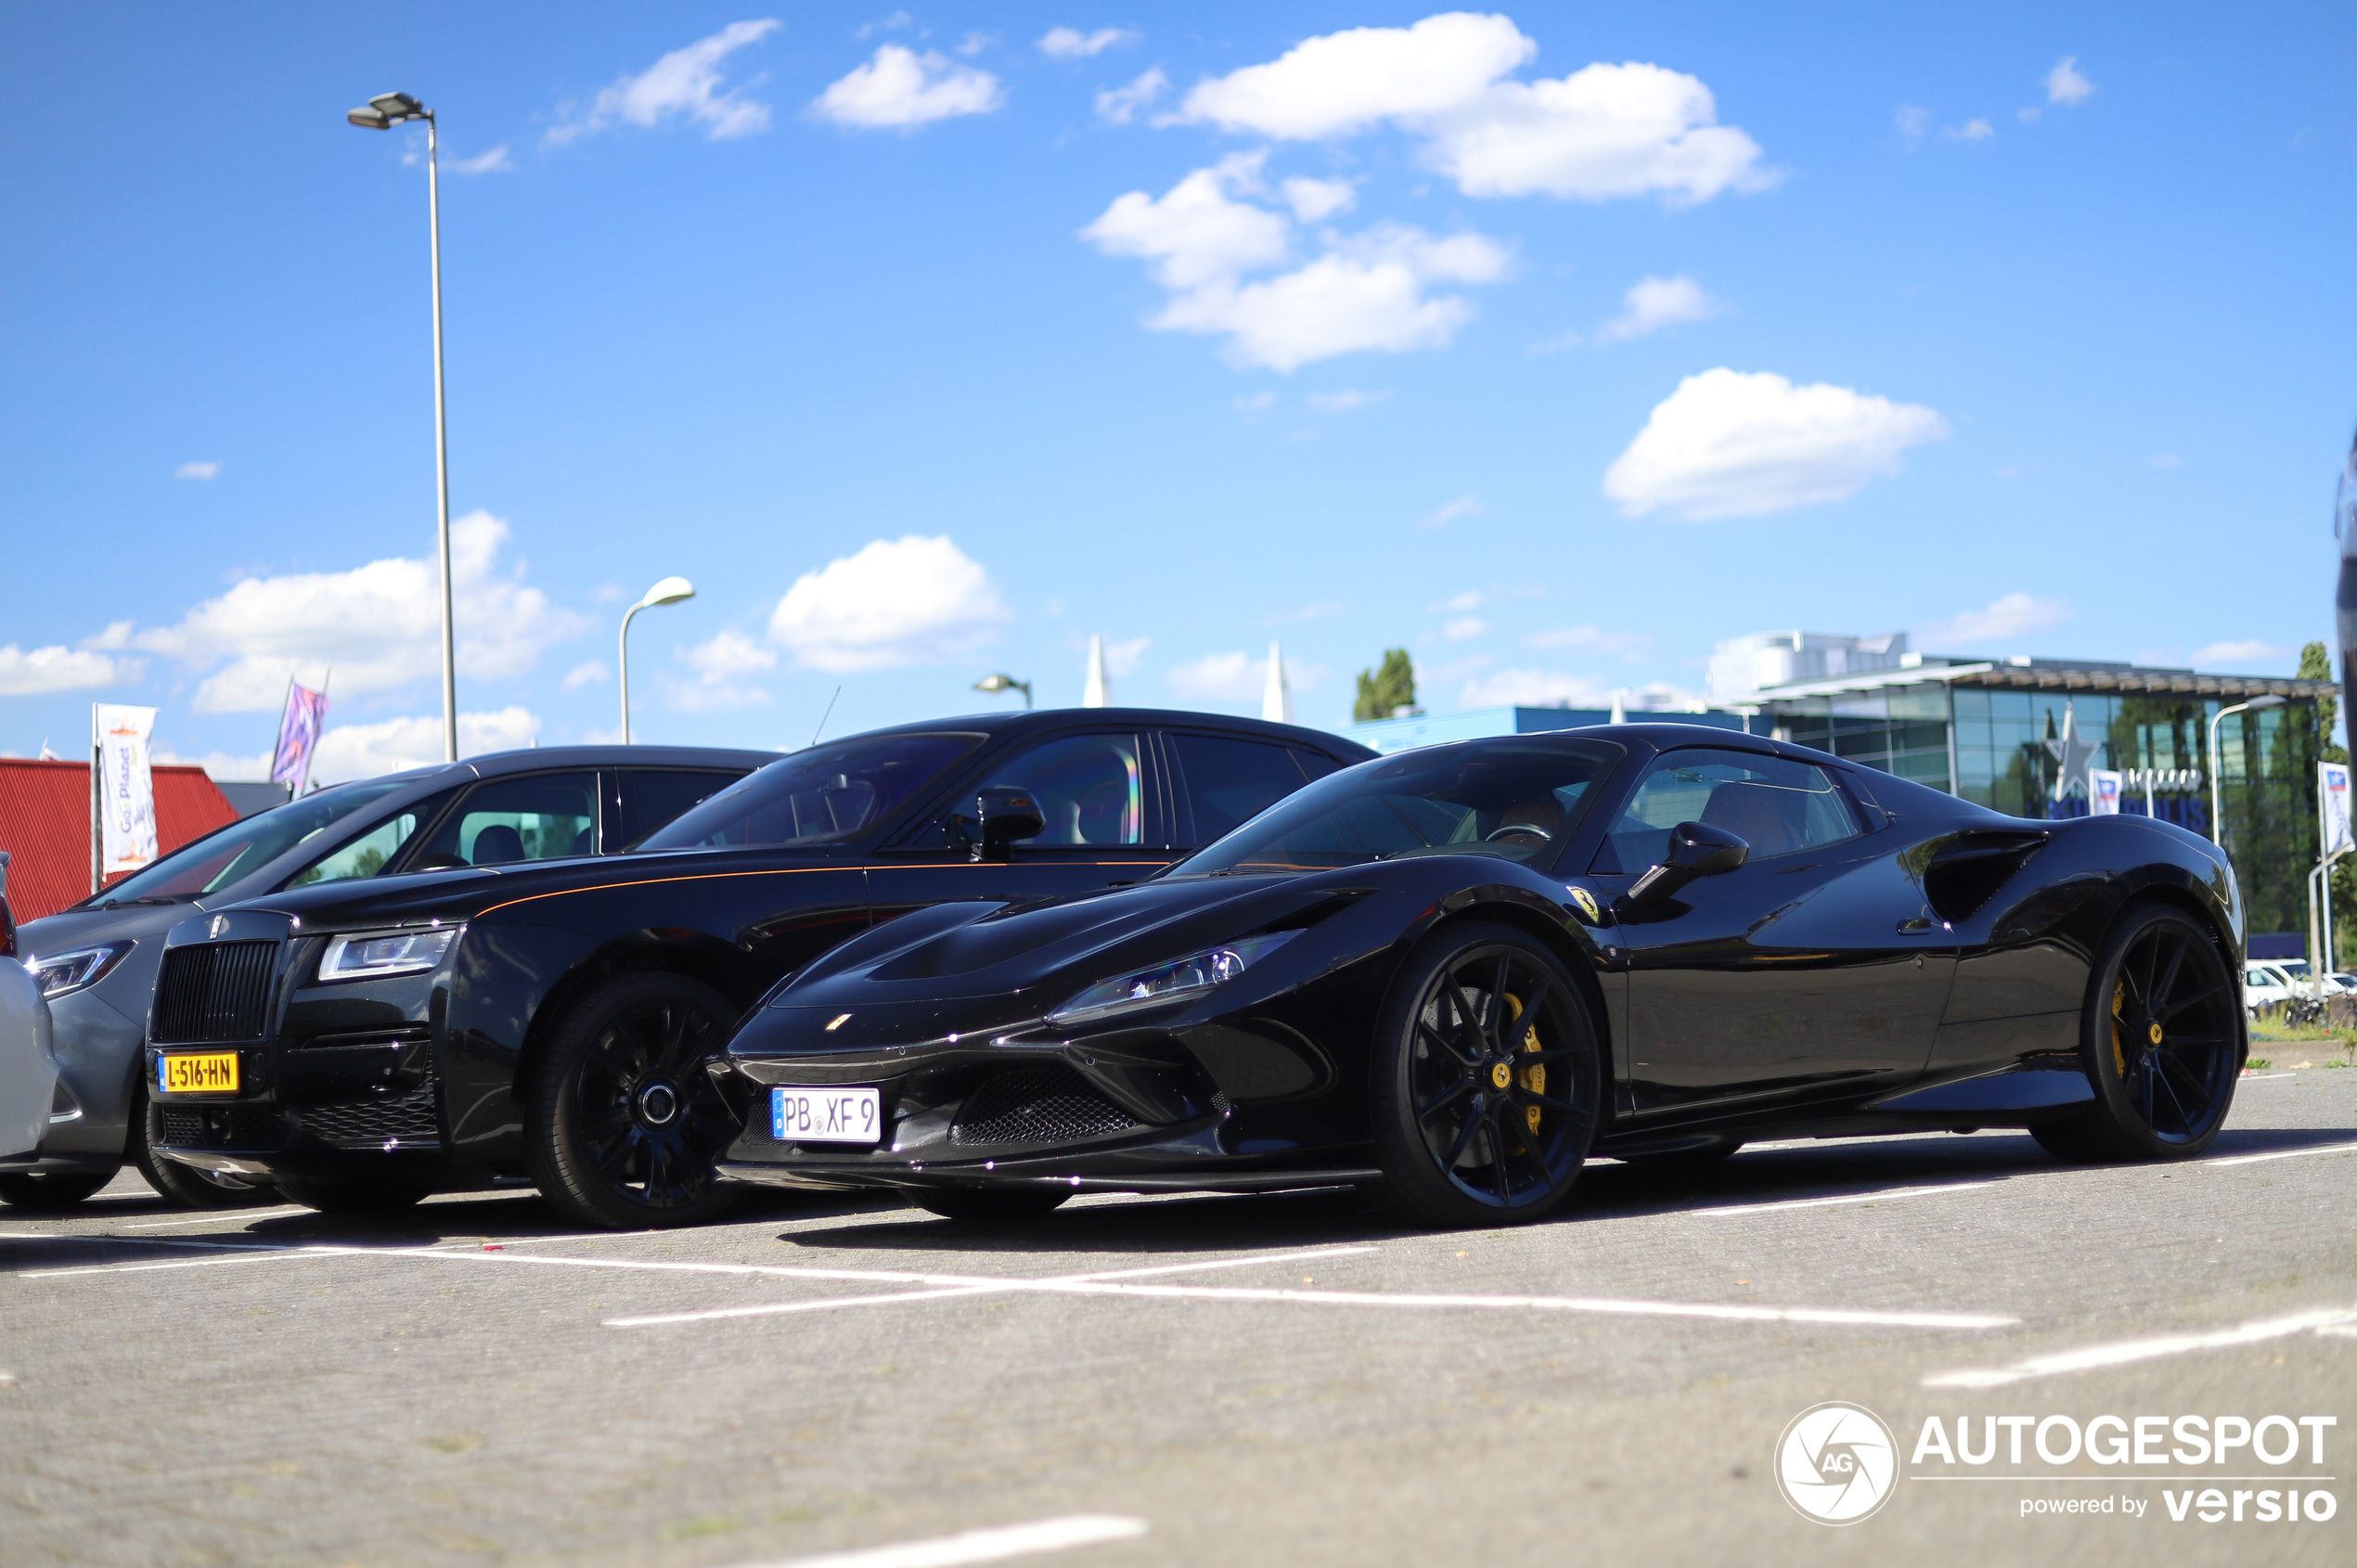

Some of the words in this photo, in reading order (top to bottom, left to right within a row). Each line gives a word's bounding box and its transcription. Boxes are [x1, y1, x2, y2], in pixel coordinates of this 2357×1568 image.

[168, 1059, 230, 1087] L-516-HN
[777, 1118, 782, 1129] D
[785, 1097, 812, 1132] PB
[827, 1098, 854, 1133] XF
[860, 1098, 875, 1133] 9
